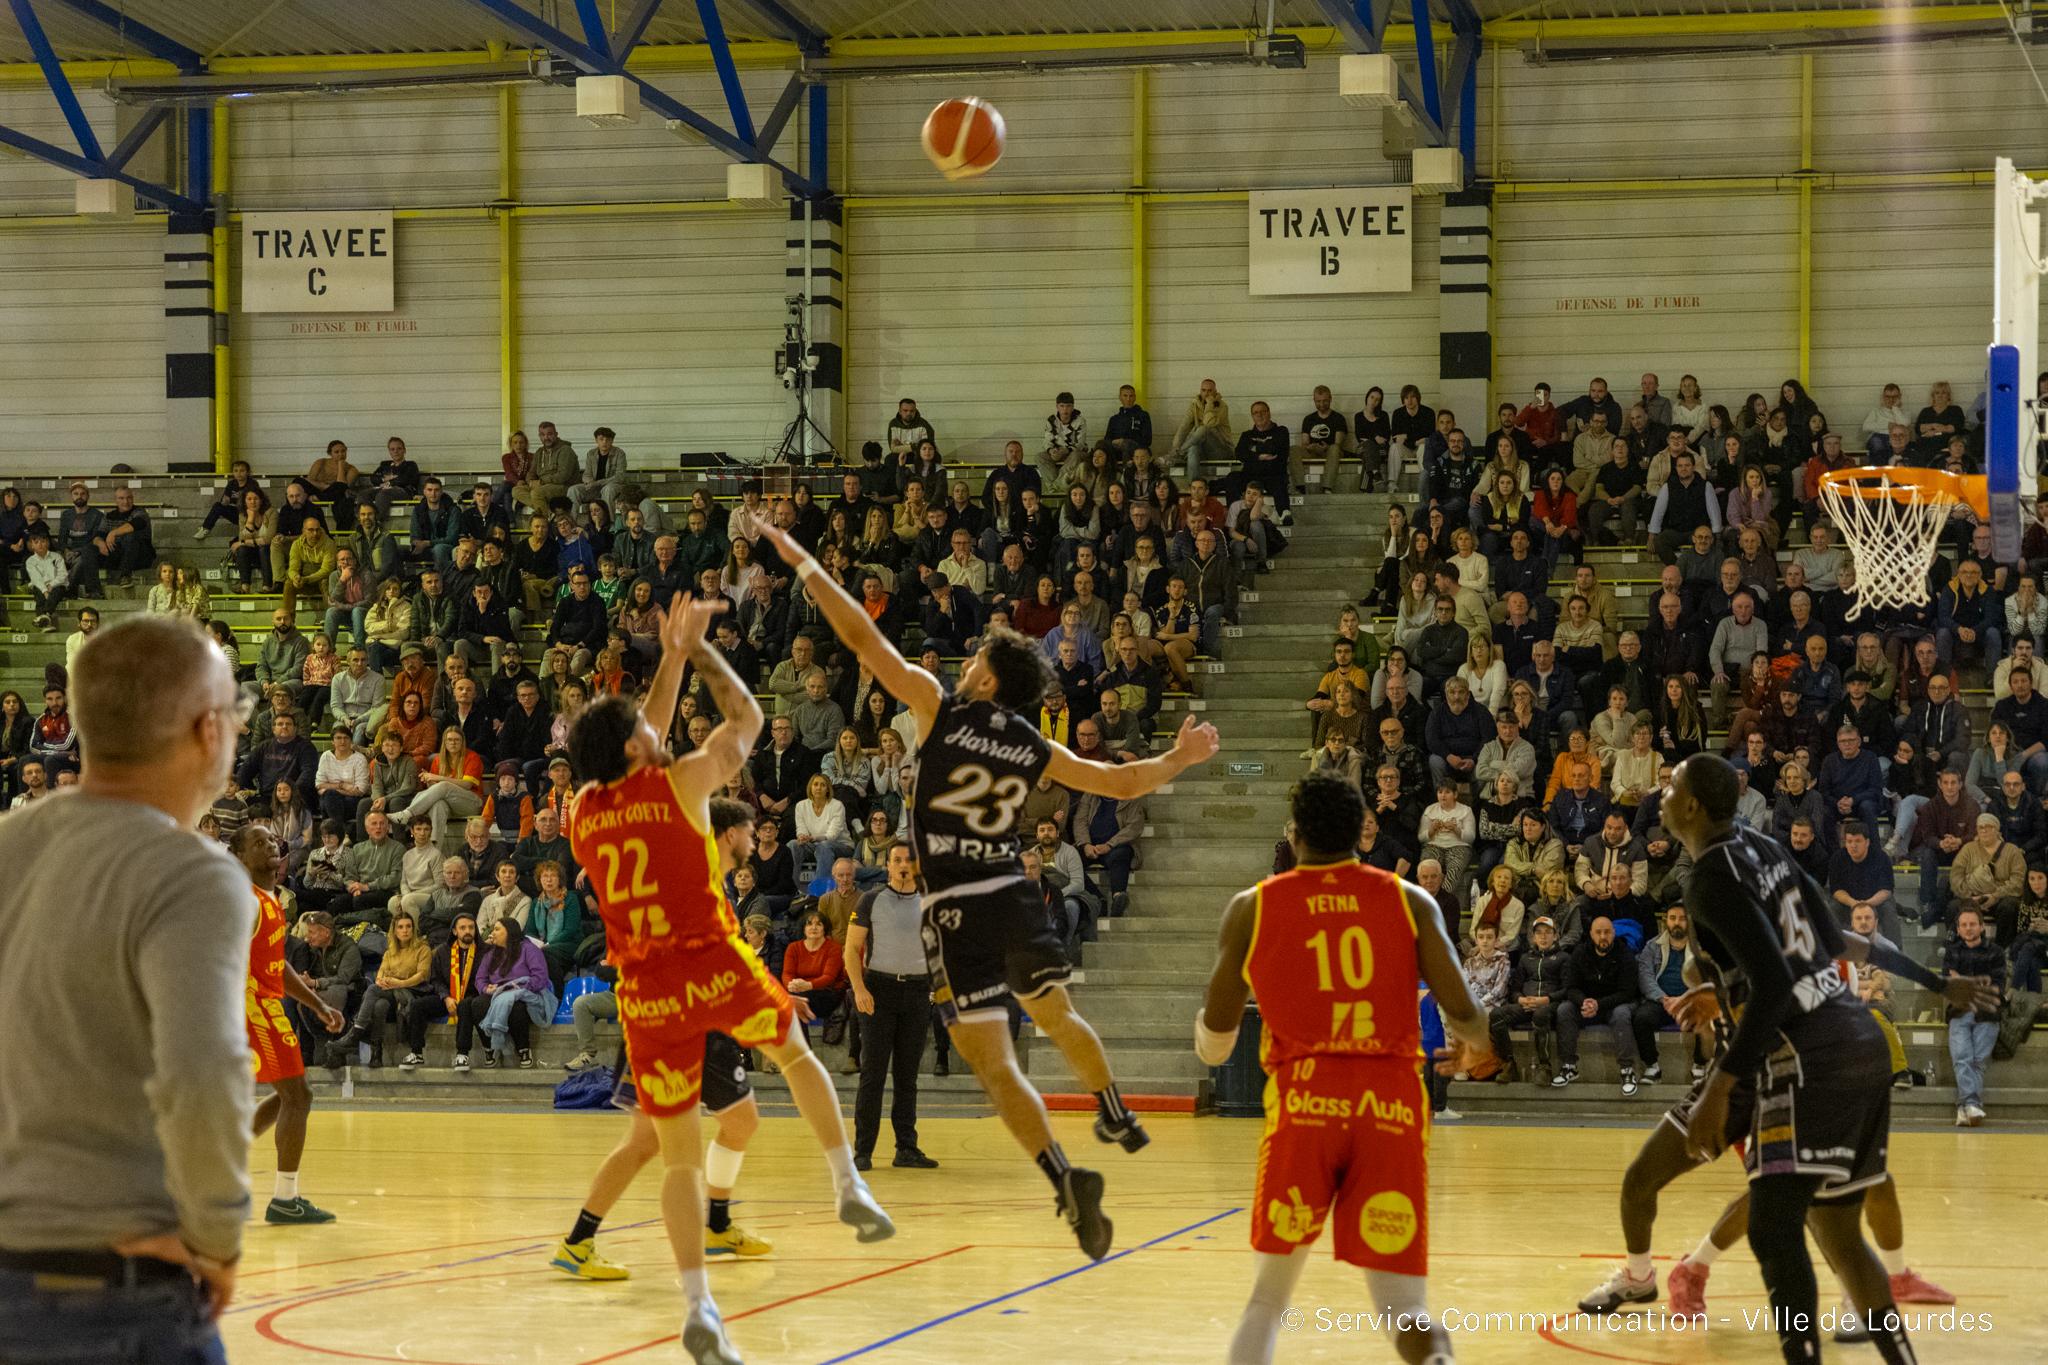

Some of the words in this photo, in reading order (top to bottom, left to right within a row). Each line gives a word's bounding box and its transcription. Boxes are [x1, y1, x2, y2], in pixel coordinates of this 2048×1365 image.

[1259, 205, 1406, 239] TRAVEE
[252, 228, 387, 259] TRAVEE
[1320, 246, 1340, 276] B
[307, 267, 327, 296] C
[1555, 298, 1617, 311] DEFENSE
[1626, 297, 1644, 309] DE
[1654, 296, 1701, 308] FUMER
[291, 321, 346, 334] DEFENSE
[355, 321, 370, 332] DE
[377, 320, 417, 332] FUMER
[944, 724, 1038, 767] Harrath
[929, 763, 1028, 836] 23
[597, 838, 659, 904] 22
[937, 908, 963, 931] 23
[1306, 894, 1360, 916] YETNA
[1305, 925, 1374, 991] 10
[623, 996, 682, 1019] Glass
[686, 970, 737, 1008] Auto
[1292, 1057, 1316, 1082] 10
[1285, 1088, 1352, 1118] Glass
[1355, 1089, 1416, 1127] Auto
